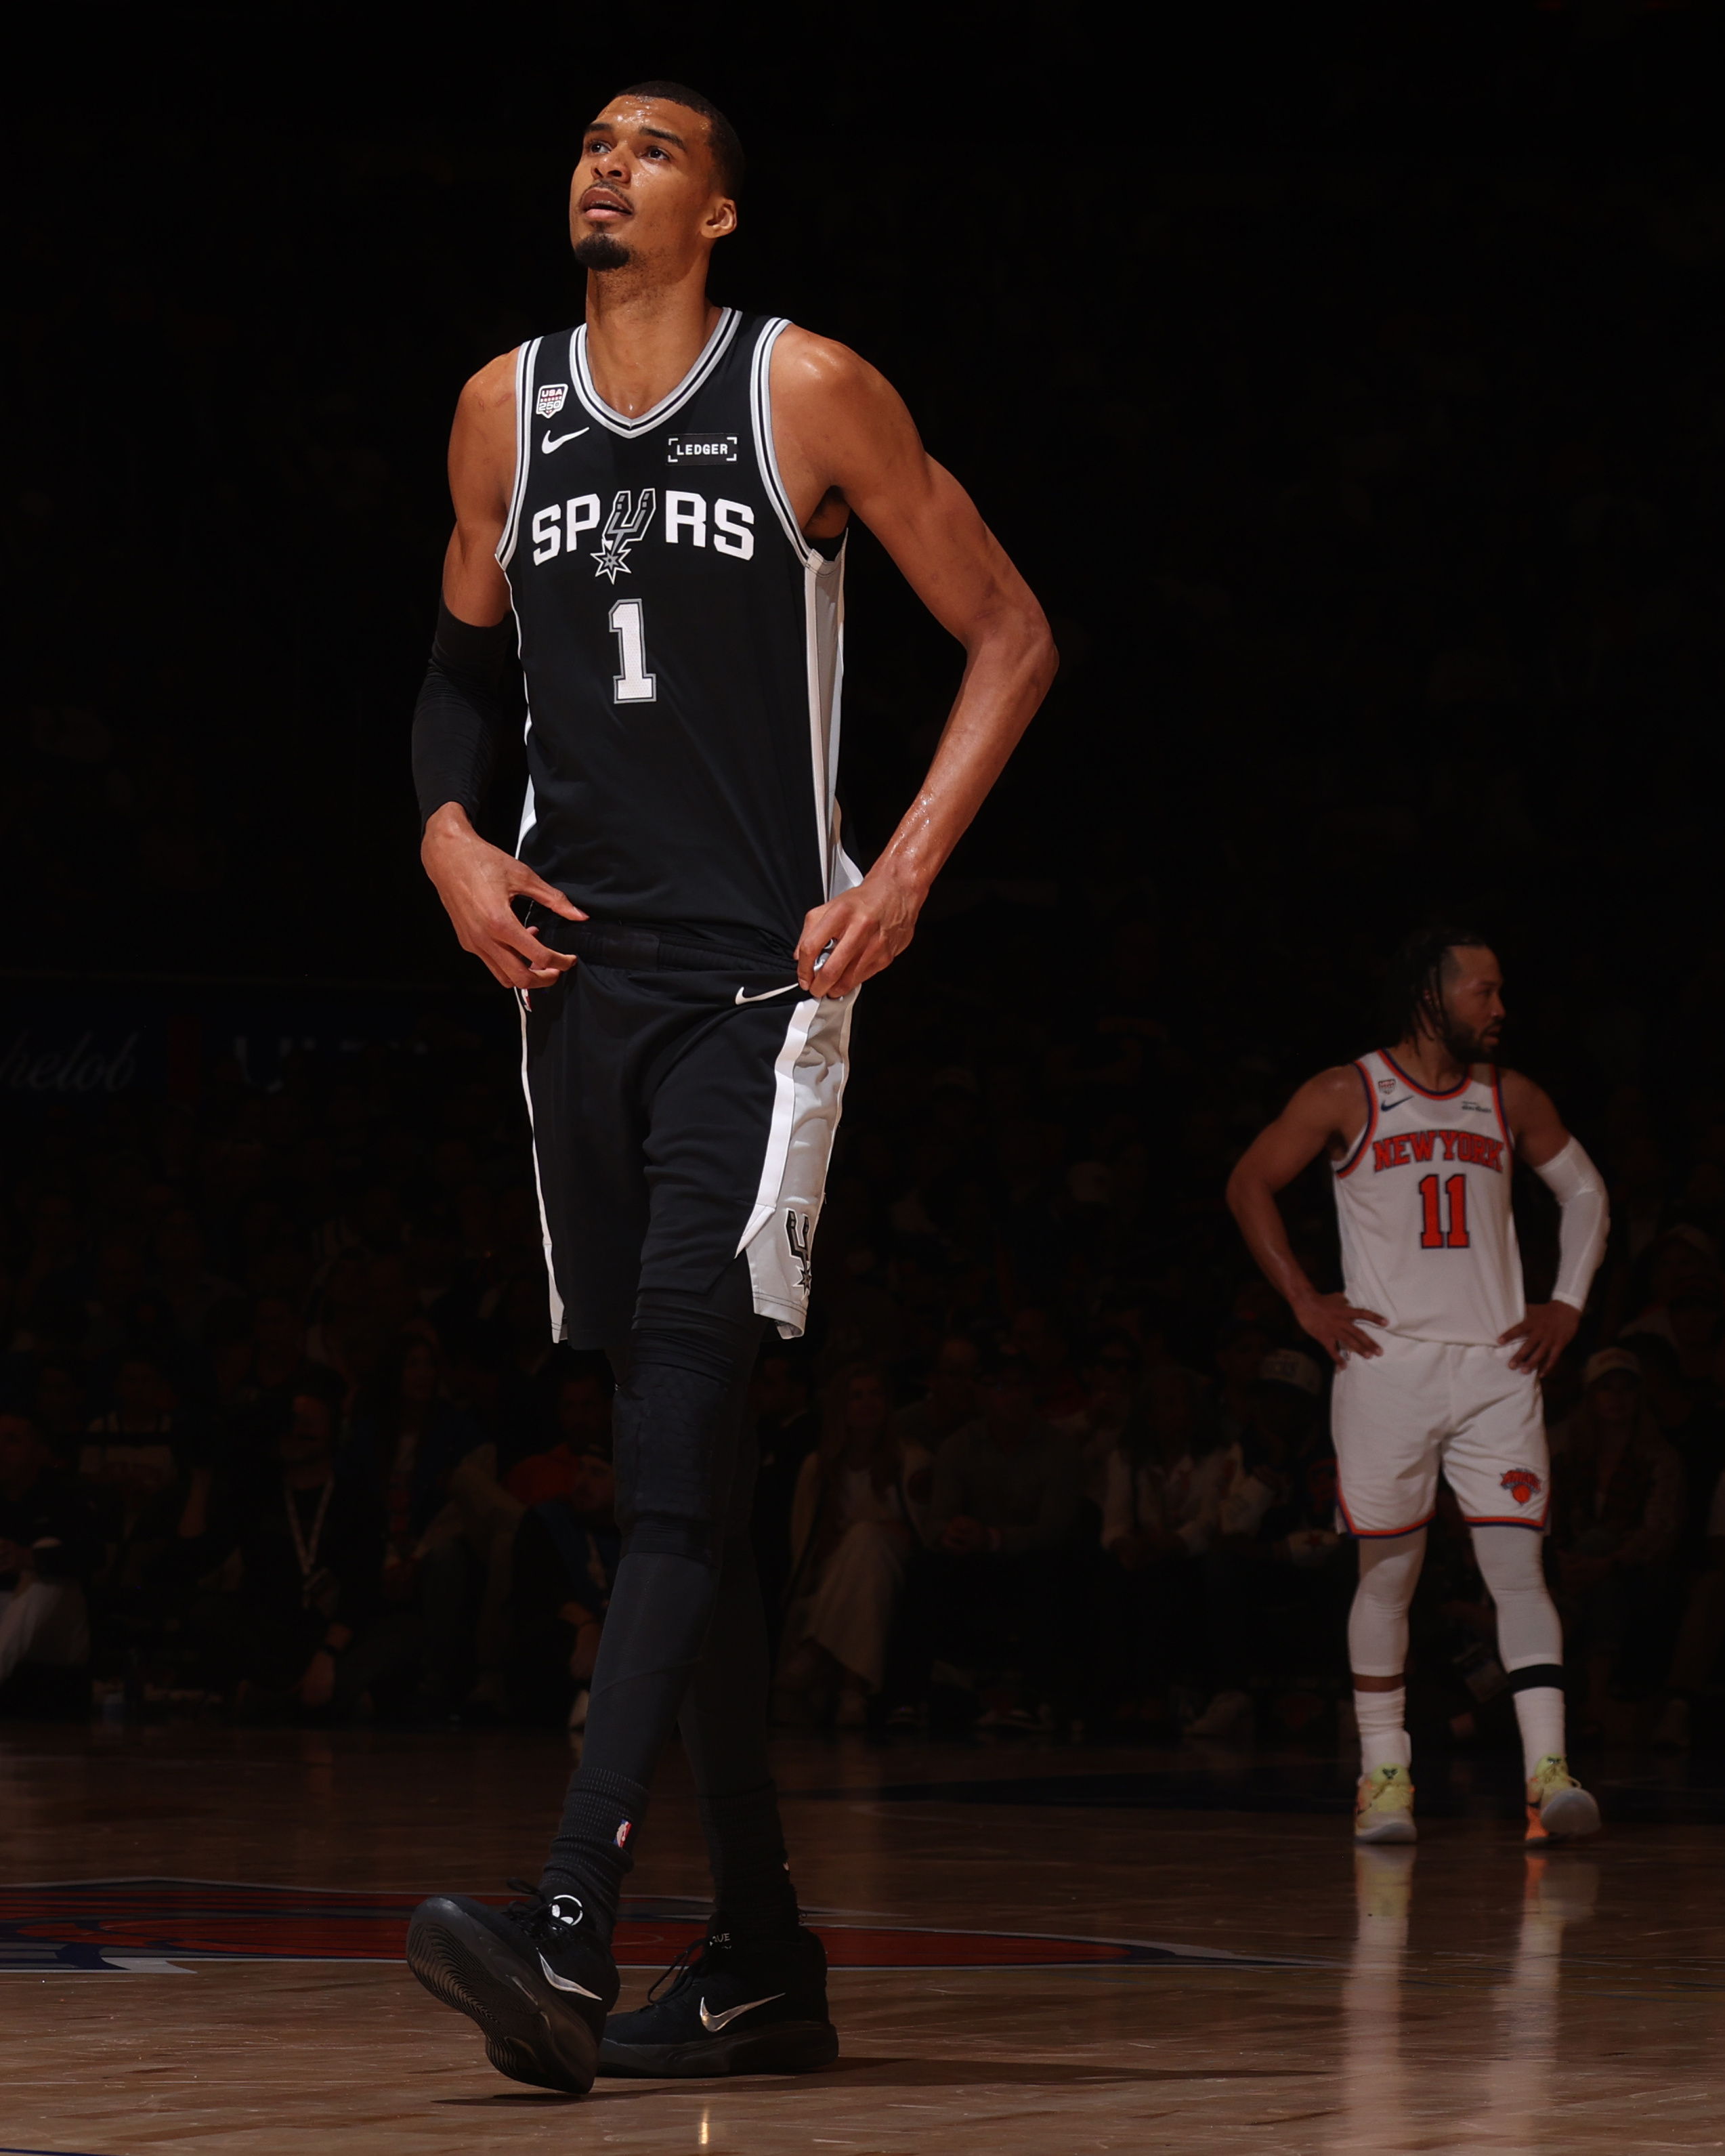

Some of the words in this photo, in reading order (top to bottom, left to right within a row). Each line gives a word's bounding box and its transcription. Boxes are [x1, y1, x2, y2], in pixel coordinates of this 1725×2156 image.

[538, 400, 561, 411] 250
[542, 388, 563, 398] USA
[677, 444, 728, 455] LEDGER
[532, 488, 754, 573] SPURS
[609, 598, 656, 704] 1
[1373, 1130, 1437, 1174] NEW
[1439, 1128, 1504, 1174] YORK
[1418, 1173, 1470, 1249] 11
